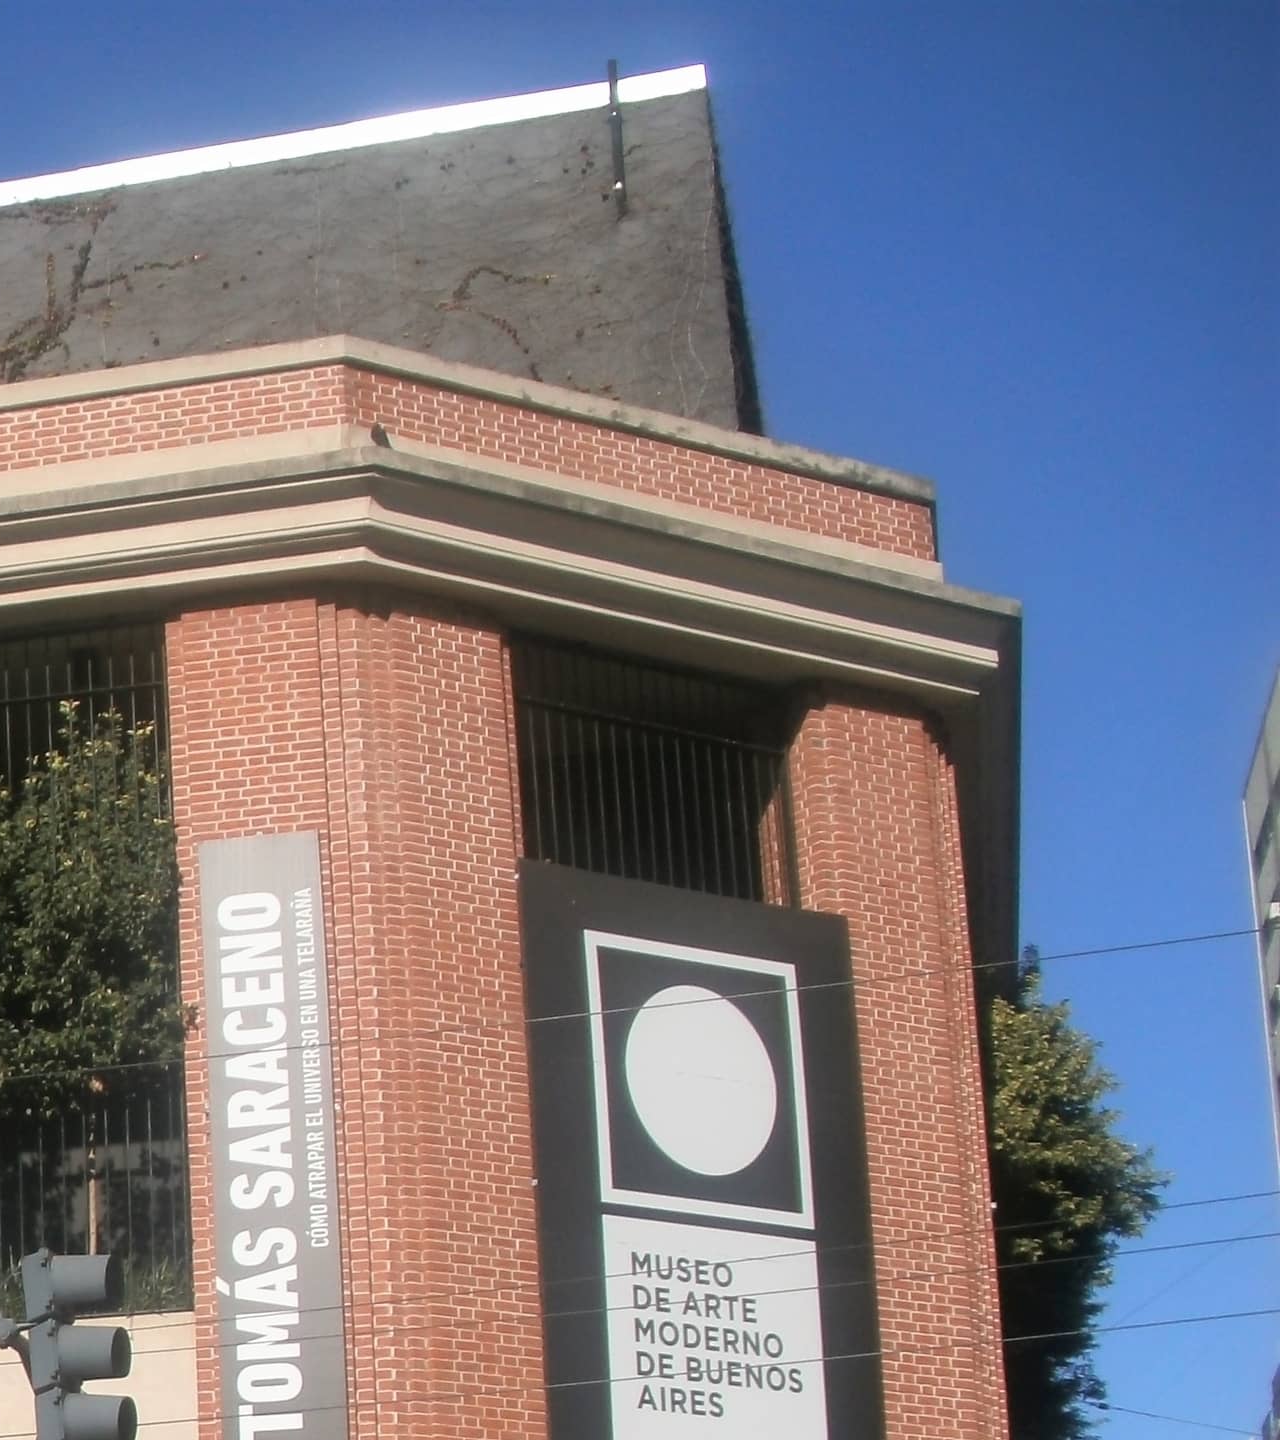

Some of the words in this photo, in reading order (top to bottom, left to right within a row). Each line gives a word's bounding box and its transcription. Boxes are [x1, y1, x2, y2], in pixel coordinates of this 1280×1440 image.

[290, 887, 315, 965] TELARAÑA
[298, 967, 317, 1002] UNA
[300, 1006, 318, 1025] EN
[217, 892, 295, 1209] SARACENO
[301, 1028, 321, 1105] UNIVERSO
[305, 1107, 324, 1128] EL
[306, 1131, 328, 1198] ATRAPAR
[305, 1204, 329, 1248] CÓMO
[631, 1251, 733, 1288] MUSEO
[632, 1284, 671, 1313] DE
[682, 1290, 758, 1324] ARTE
[634, 1317, 784, 1359] MODERNO
[636, 1350, 675, 1380] DE
[686, 1356, 804, 1394] BUENOS
[637, 1384, 725, 1418] AIRES
